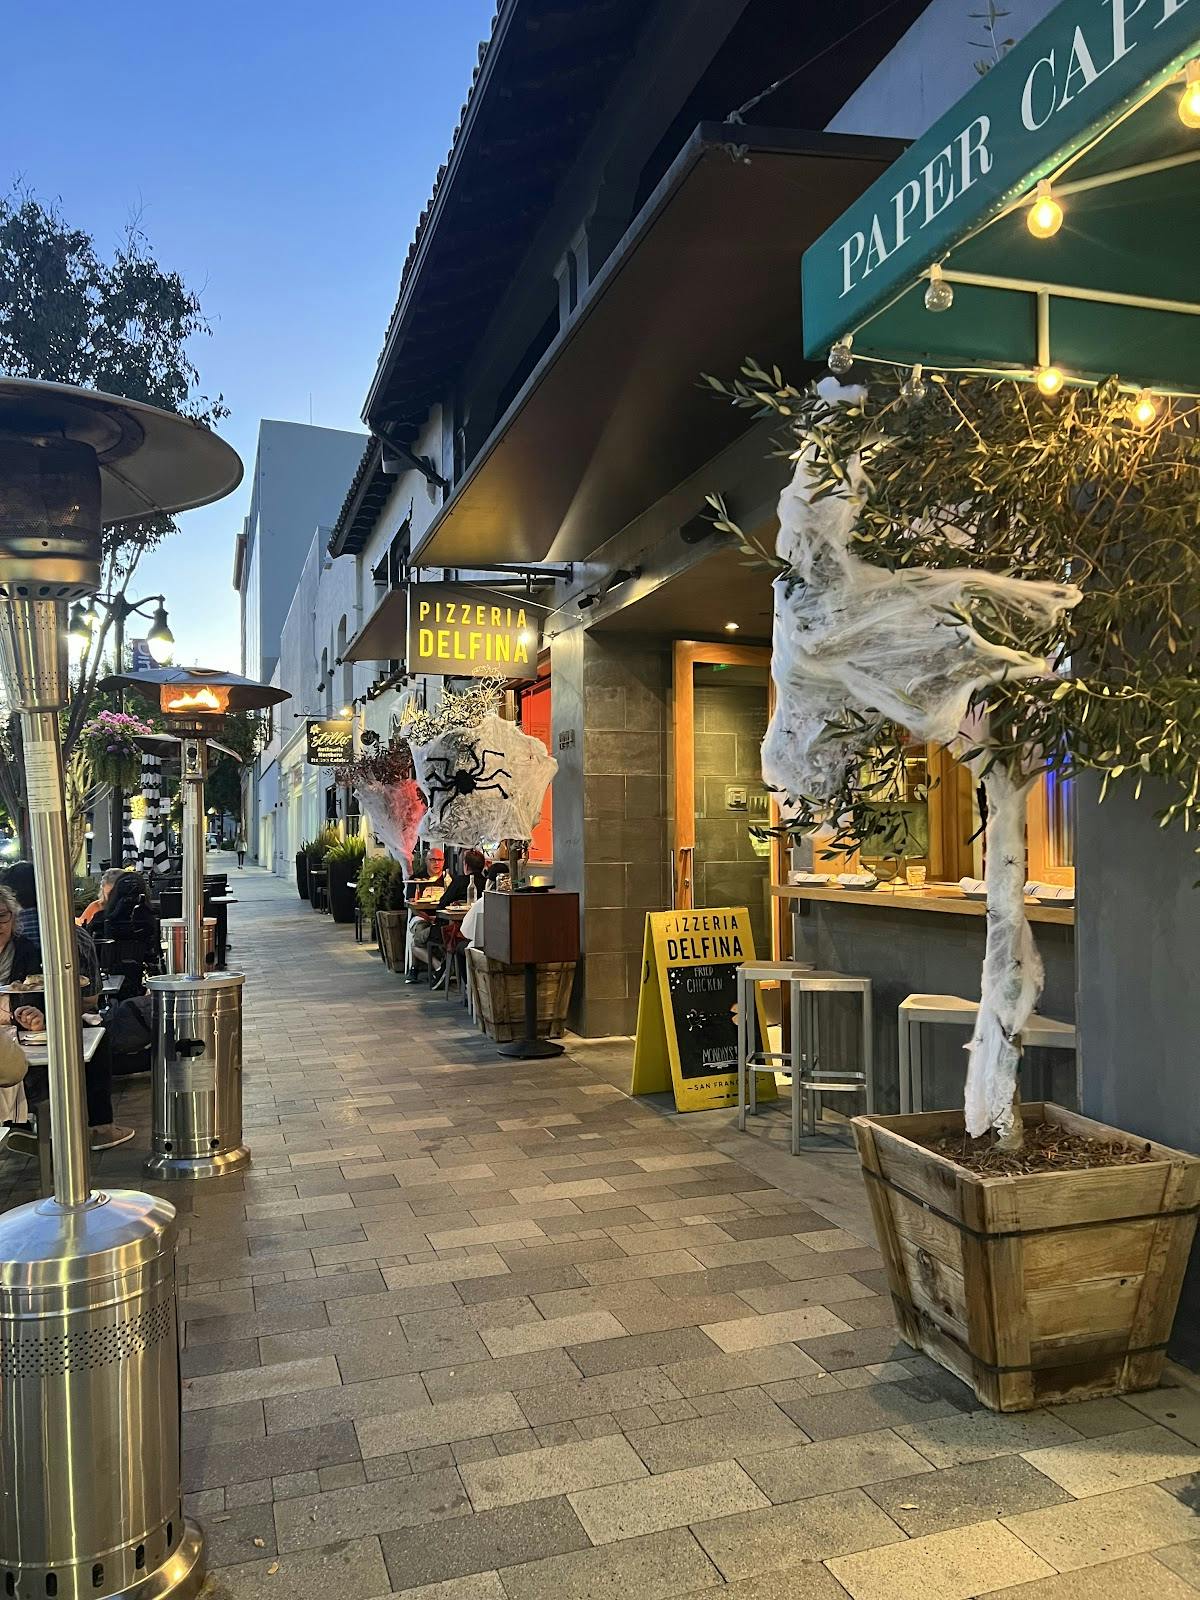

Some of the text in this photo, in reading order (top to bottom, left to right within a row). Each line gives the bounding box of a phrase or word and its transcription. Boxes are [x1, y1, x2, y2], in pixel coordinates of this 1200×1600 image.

[838, 0, 1189, 299] PAPER CAP
[419, 601, 527, 629] PIZZERIA
[419, 628, 528, 664] DELFINA
[667, 936, 743, 961] DELFINA
[694, 966, 714, 977] FRIED
[686, 978, 723, 993] CHICKEN
[694, 1082, 711, 1091] SAN
